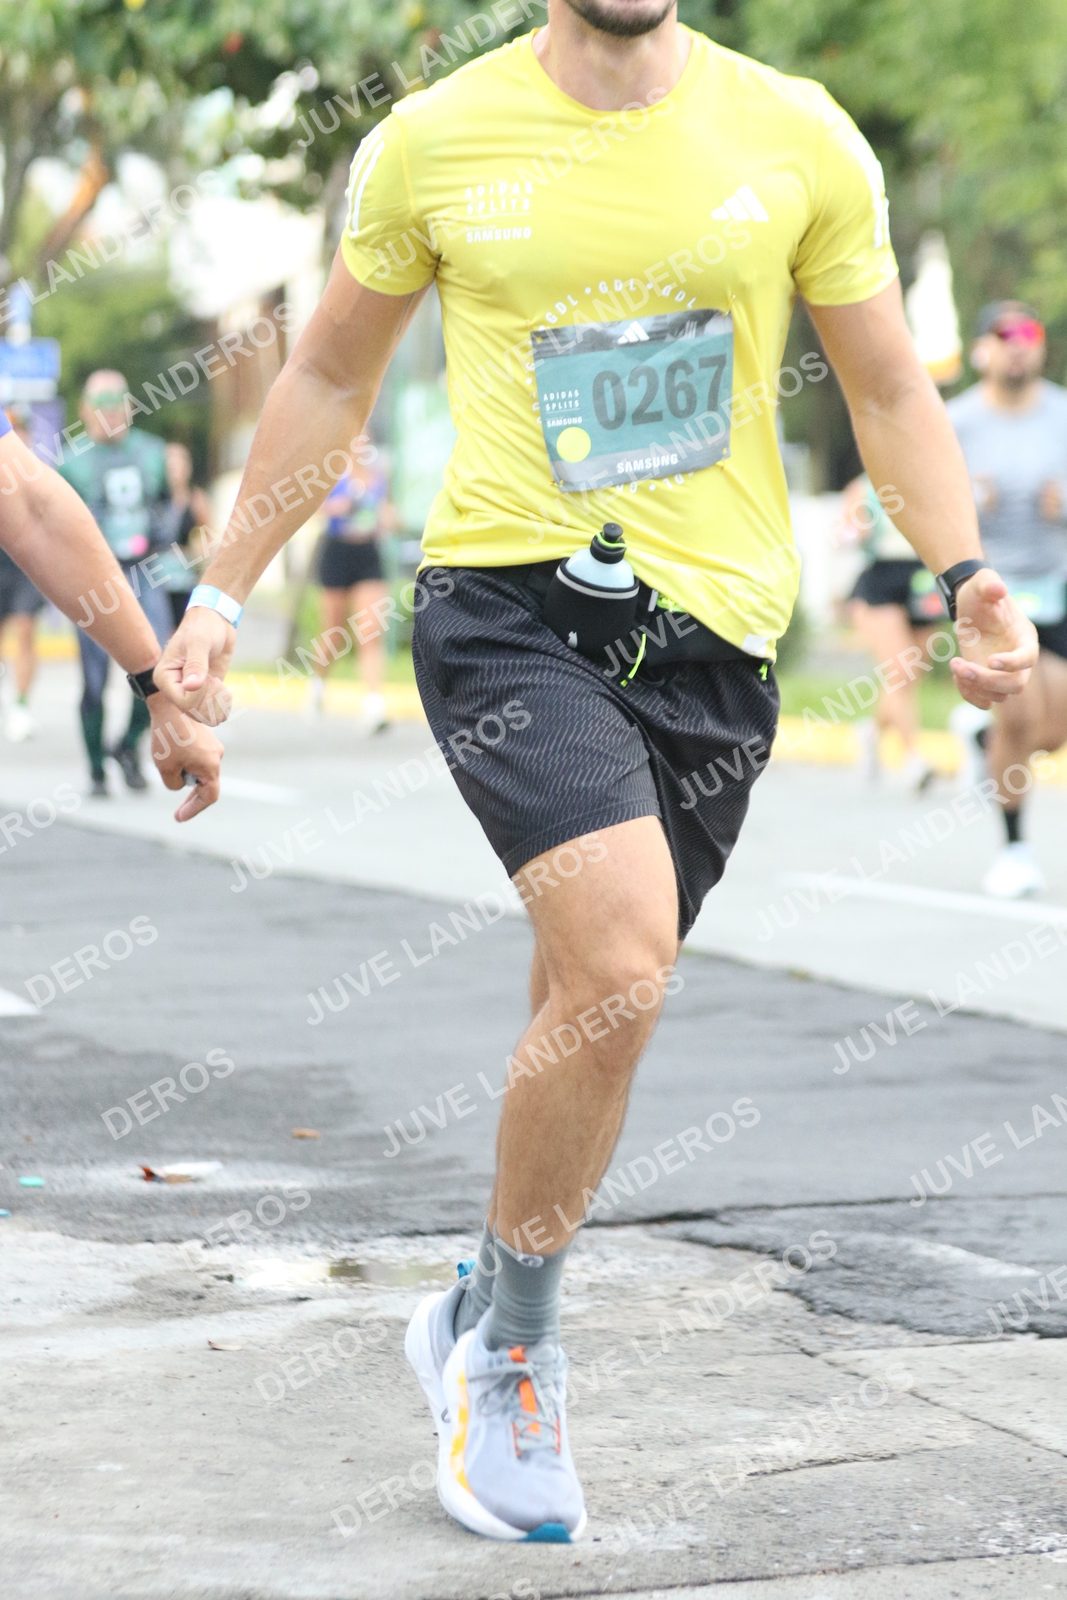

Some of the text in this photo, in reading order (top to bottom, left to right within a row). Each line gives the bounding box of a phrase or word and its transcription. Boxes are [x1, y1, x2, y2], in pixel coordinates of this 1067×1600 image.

[464, 181, 533, 200] ADIDAS
[465, 198, 530, 215] SPLITS
[465, 226, 532, 244] SAMSUNG
[545, 294, 578, 324] GDL
[598, 278, 636, 294] GDL
[543, 389, 580, 401] ADIDAS
[592, 353, 727, 431] 0267
[545, 399, 580, 411] SPLITS
[546, 416, 583, 428] SAMSUNG
[616, 453, 678, 473] SAMSUNG
